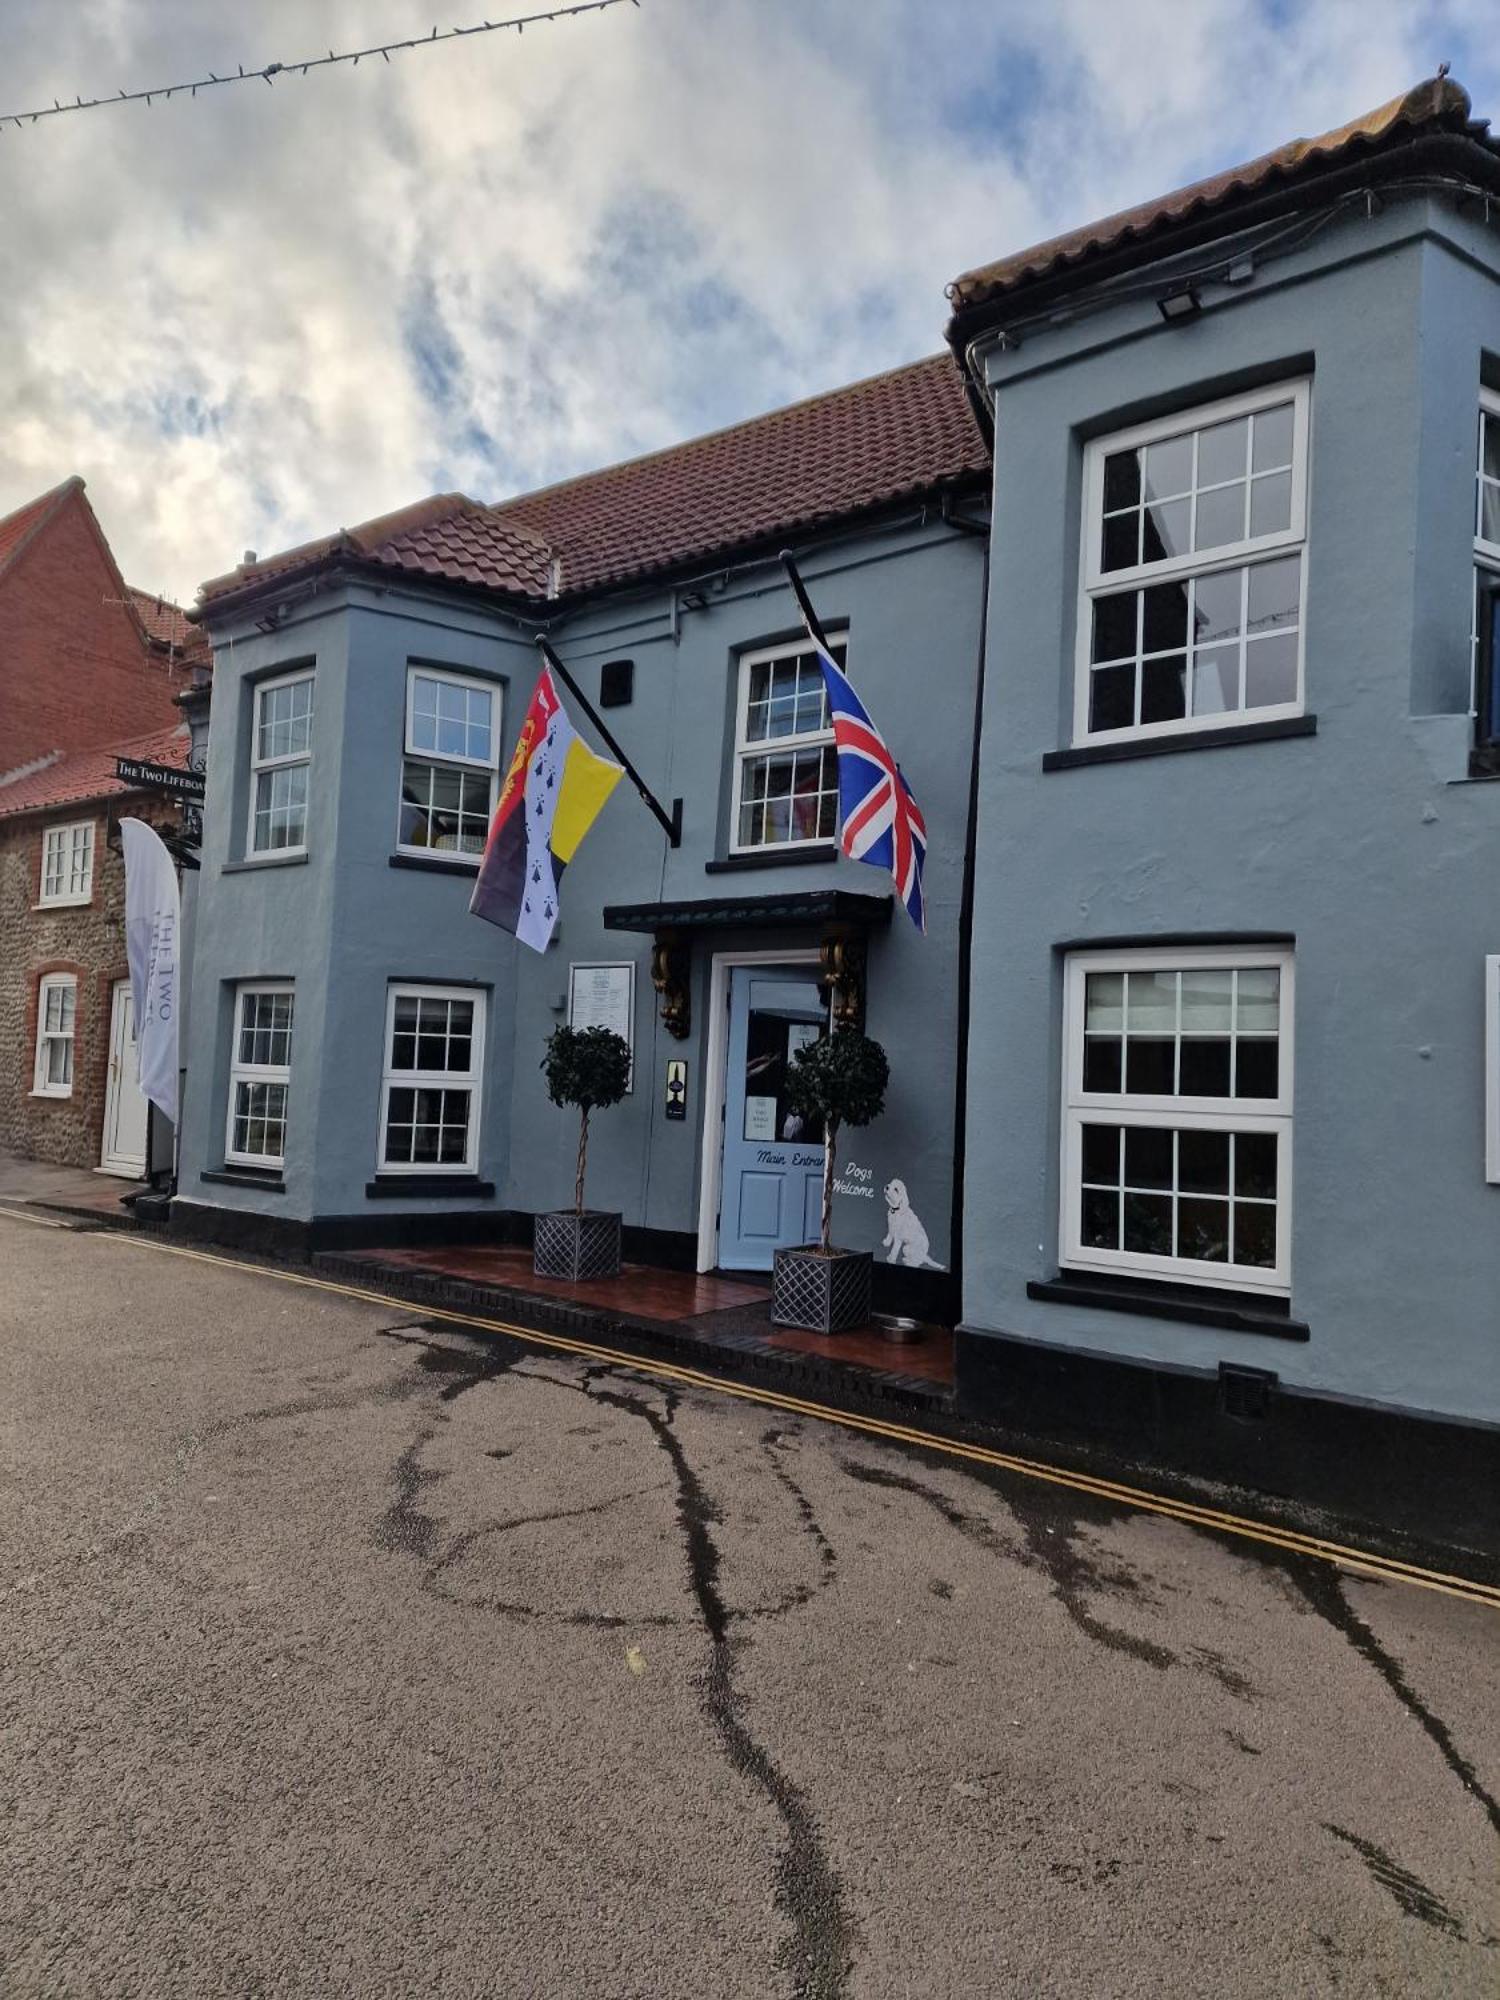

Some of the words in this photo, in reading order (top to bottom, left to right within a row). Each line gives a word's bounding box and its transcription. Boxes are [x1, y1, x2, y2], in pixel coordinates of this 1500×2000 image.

[119, 761, 138, 777] THE
[139, 765, 162, 782] TWO
[163, 771, 204, 791] LIFEBOA
[159, 908, 174, 959] THE
[159, 962, 174, 1021] TWO
[757, 1150, 786, 1165] Main
[791, 1152, 825, 1167] Entran
[845, 1161, 872, 1182] Dogs
[832, 1178, 875, 1198] Welcome
